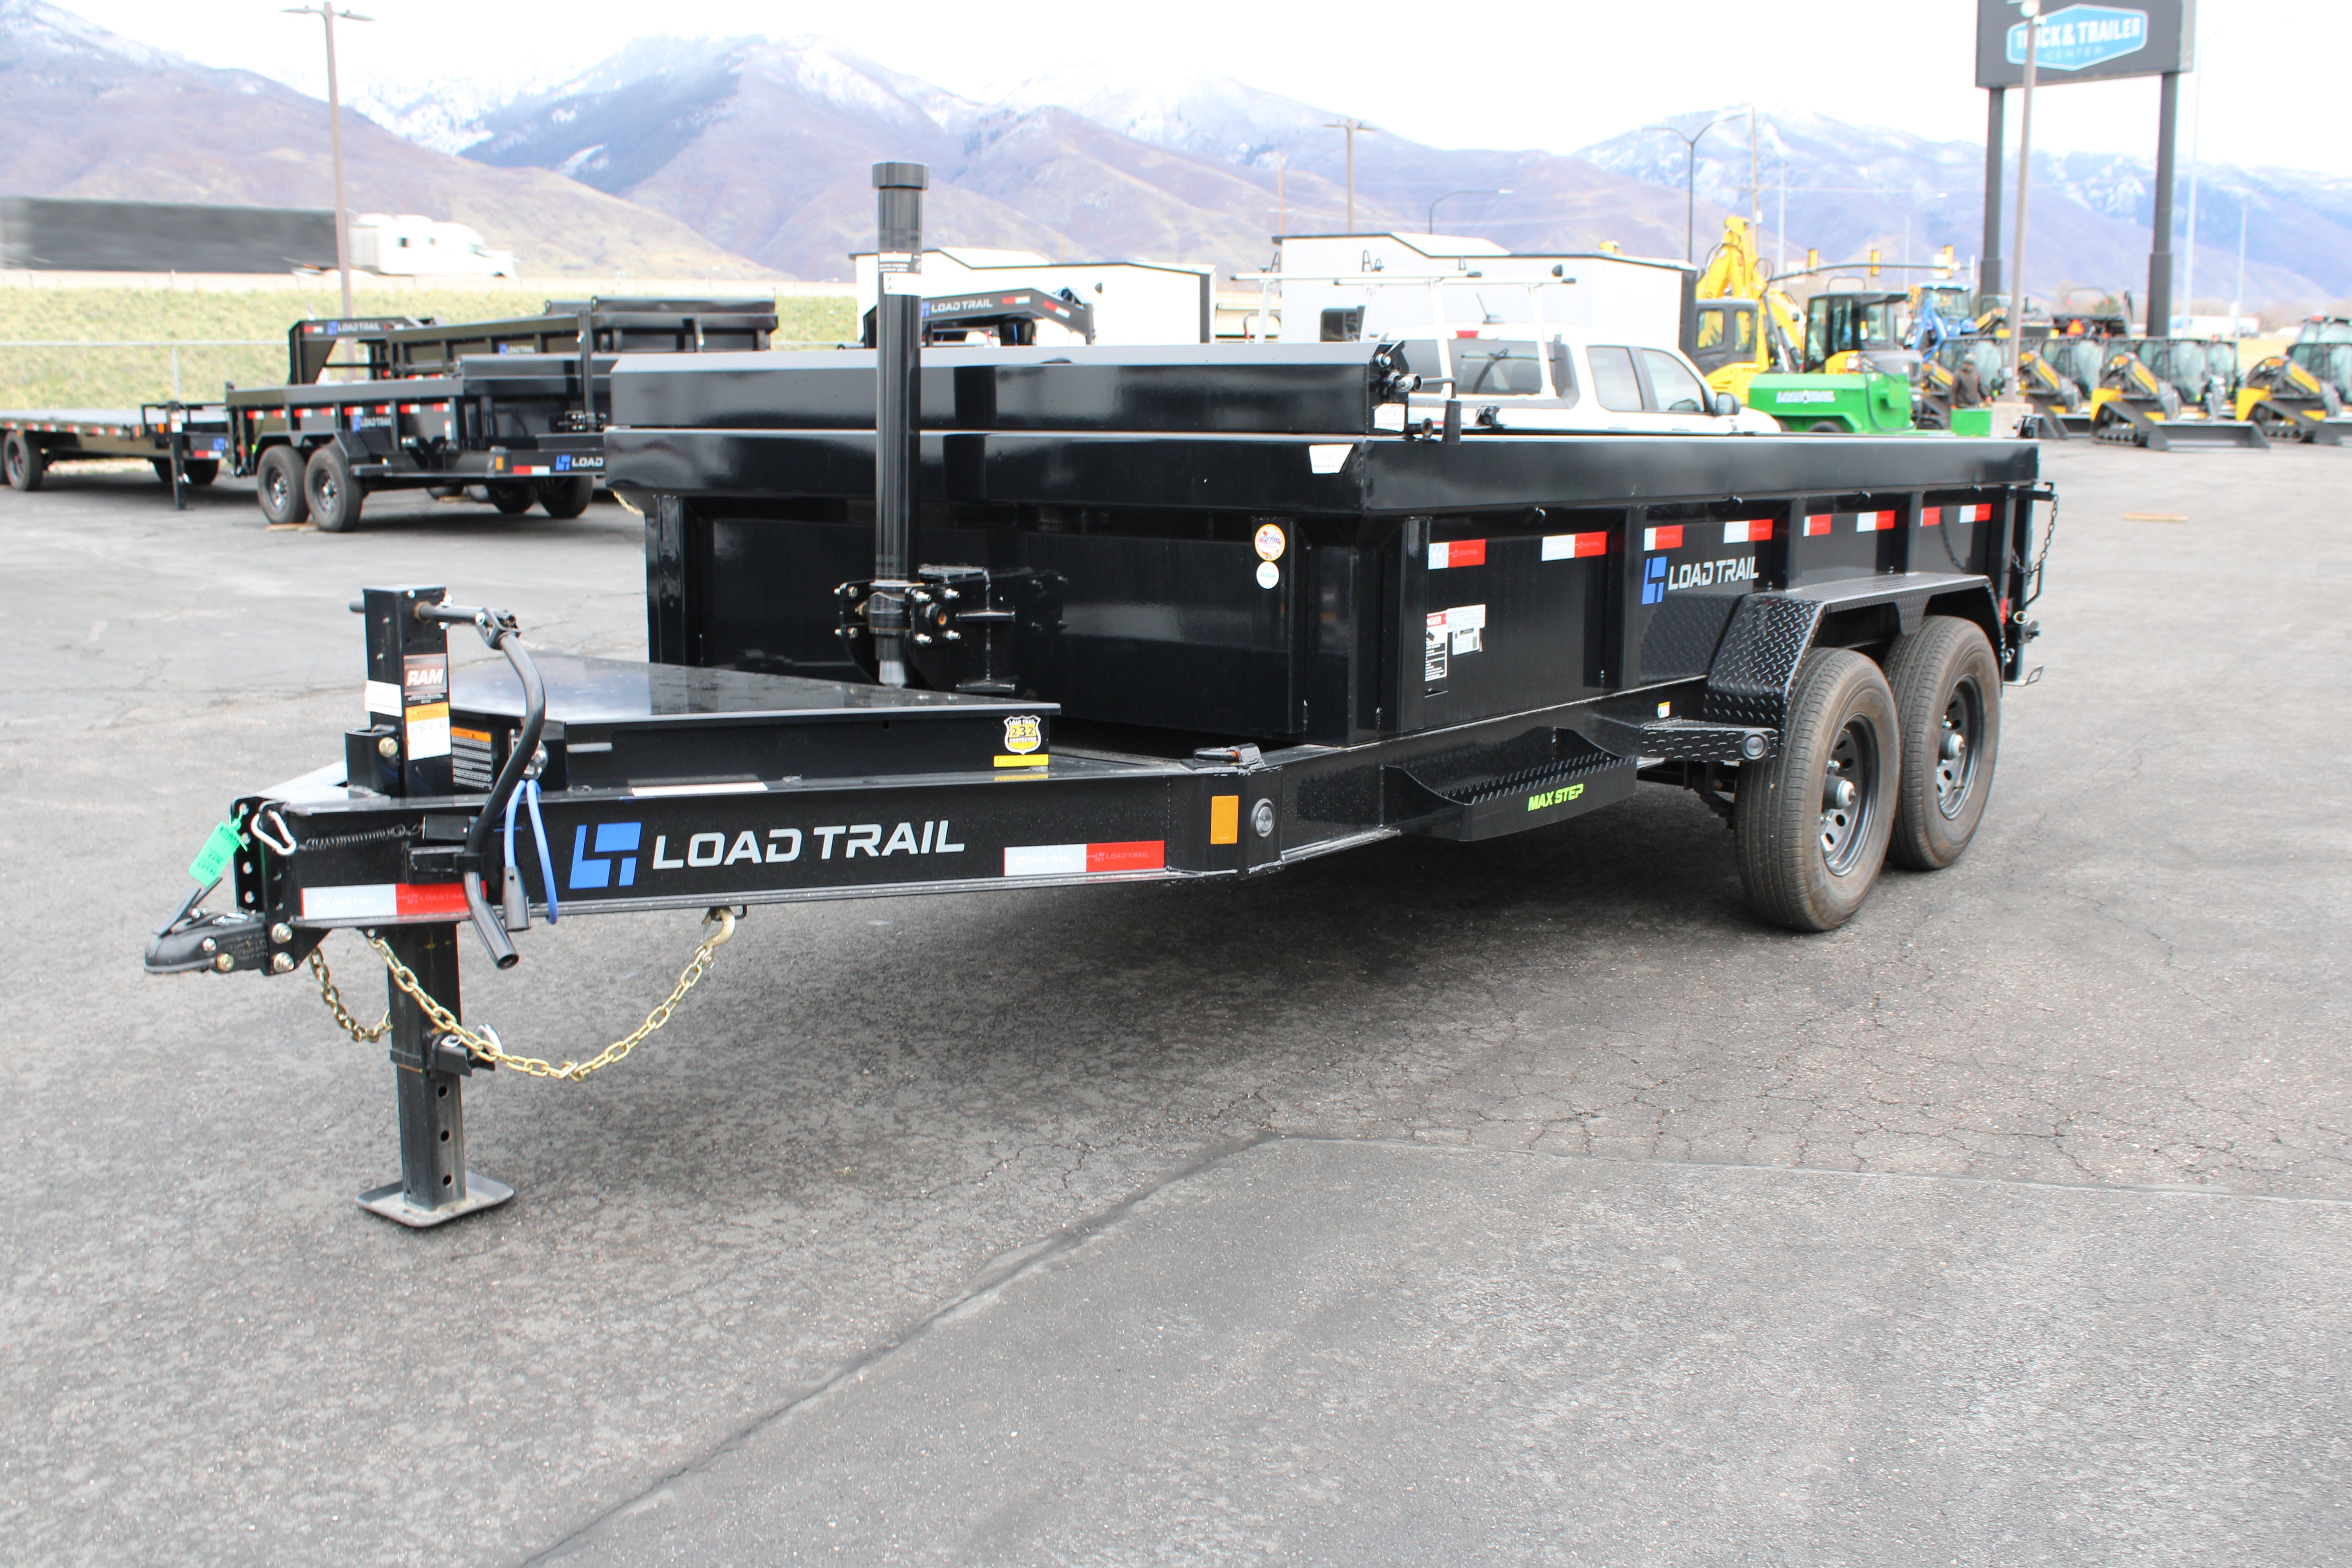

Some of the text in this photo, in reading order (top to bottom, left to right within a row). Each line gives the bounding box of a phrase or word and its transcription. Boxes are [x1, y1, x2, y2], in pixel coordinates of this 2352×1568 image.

[2016, 17, 2141, 49] TUCK & TRAILER
[931, 298, 993, 314] LOAD TRAIL
[359, 321, 381, 332] TRAIL
[572, 456, 604, 468] LOAD
[1668, 561, 1714, 590] LOAD
[1716, 556, 1760, 584] TRAIL
[1427, 616, 1442, 626] NGER
[406, 668, 444, 686] RAM
[1012, 726, 1034, 737] 232
[1527, 783, 1584, 812] MAX STEP
[653, 828, 803, 870] LOAD
[813, 820, 966, 860] TRAIL
[419, 893, 445, 902] LOAD
